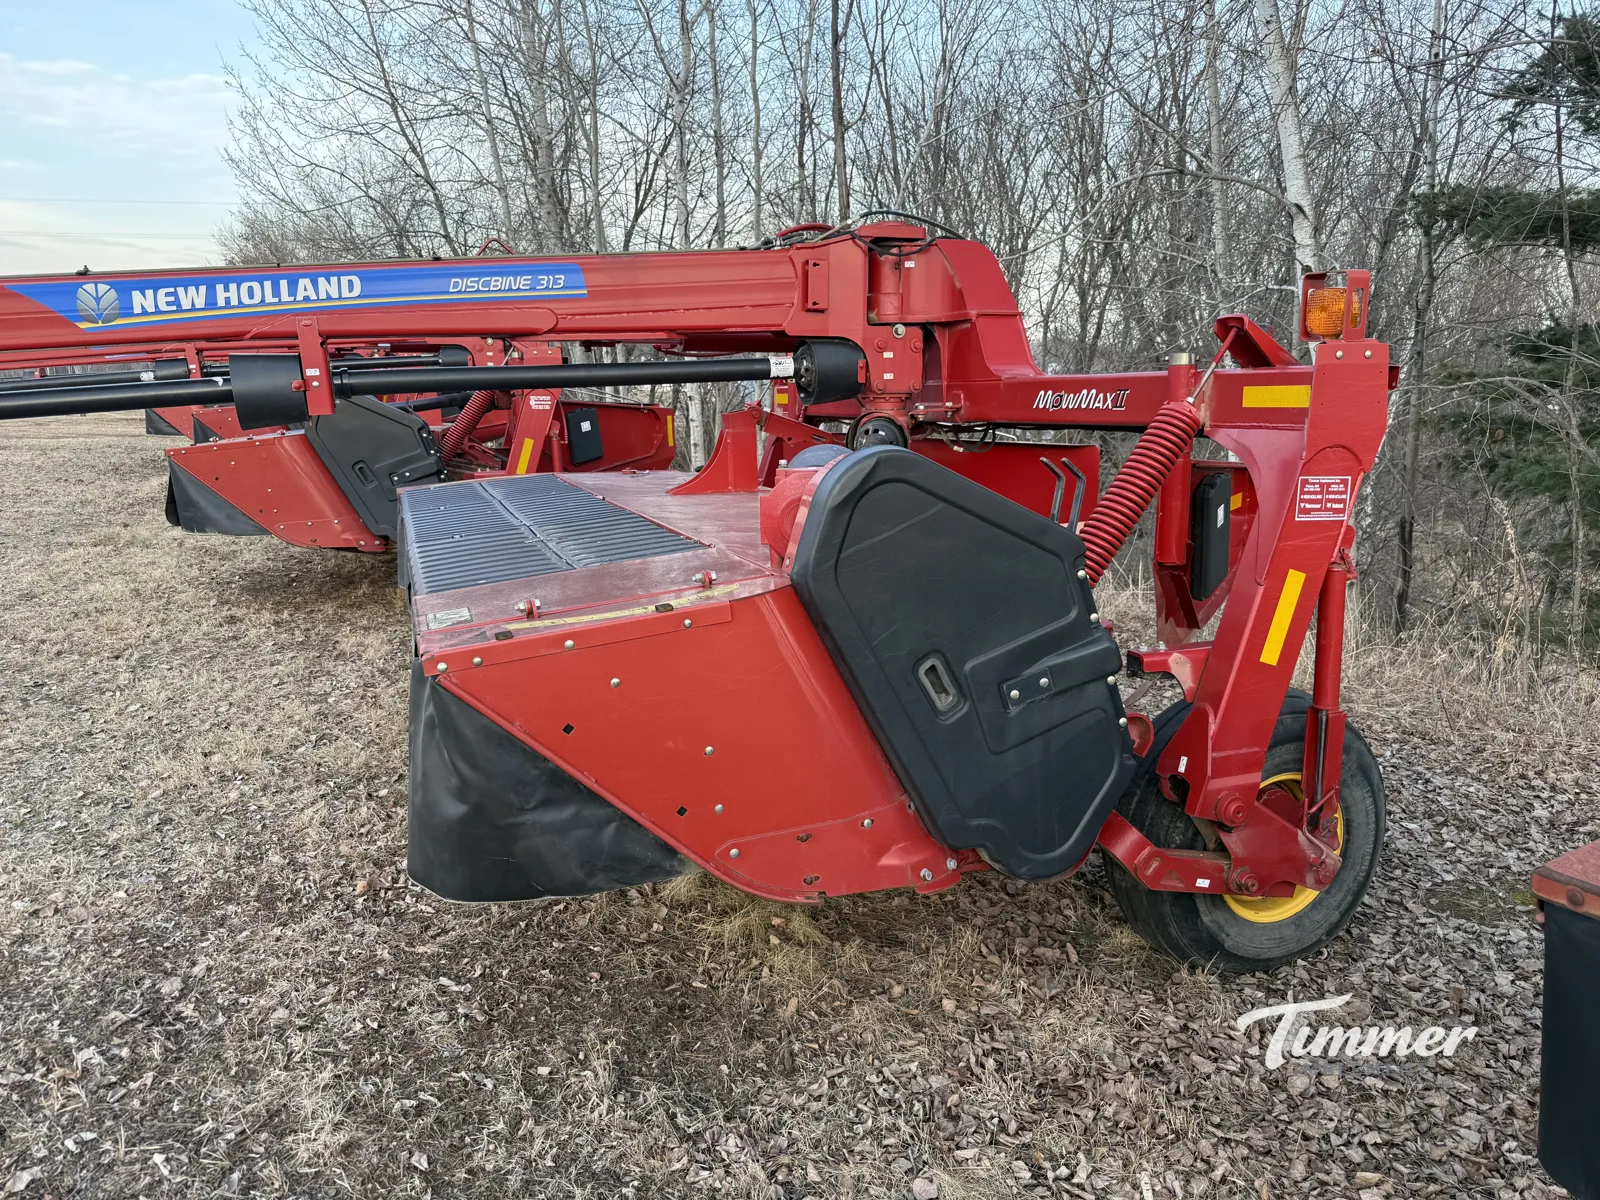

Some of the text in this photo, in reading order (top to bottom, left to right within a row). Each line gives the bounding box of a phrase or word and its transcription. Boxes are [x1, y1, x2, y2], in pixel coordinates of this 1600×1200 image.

[131, 275, 362, 314] NEW HOLLAND
[449, 275, 565, 292] DISCBINE 313
